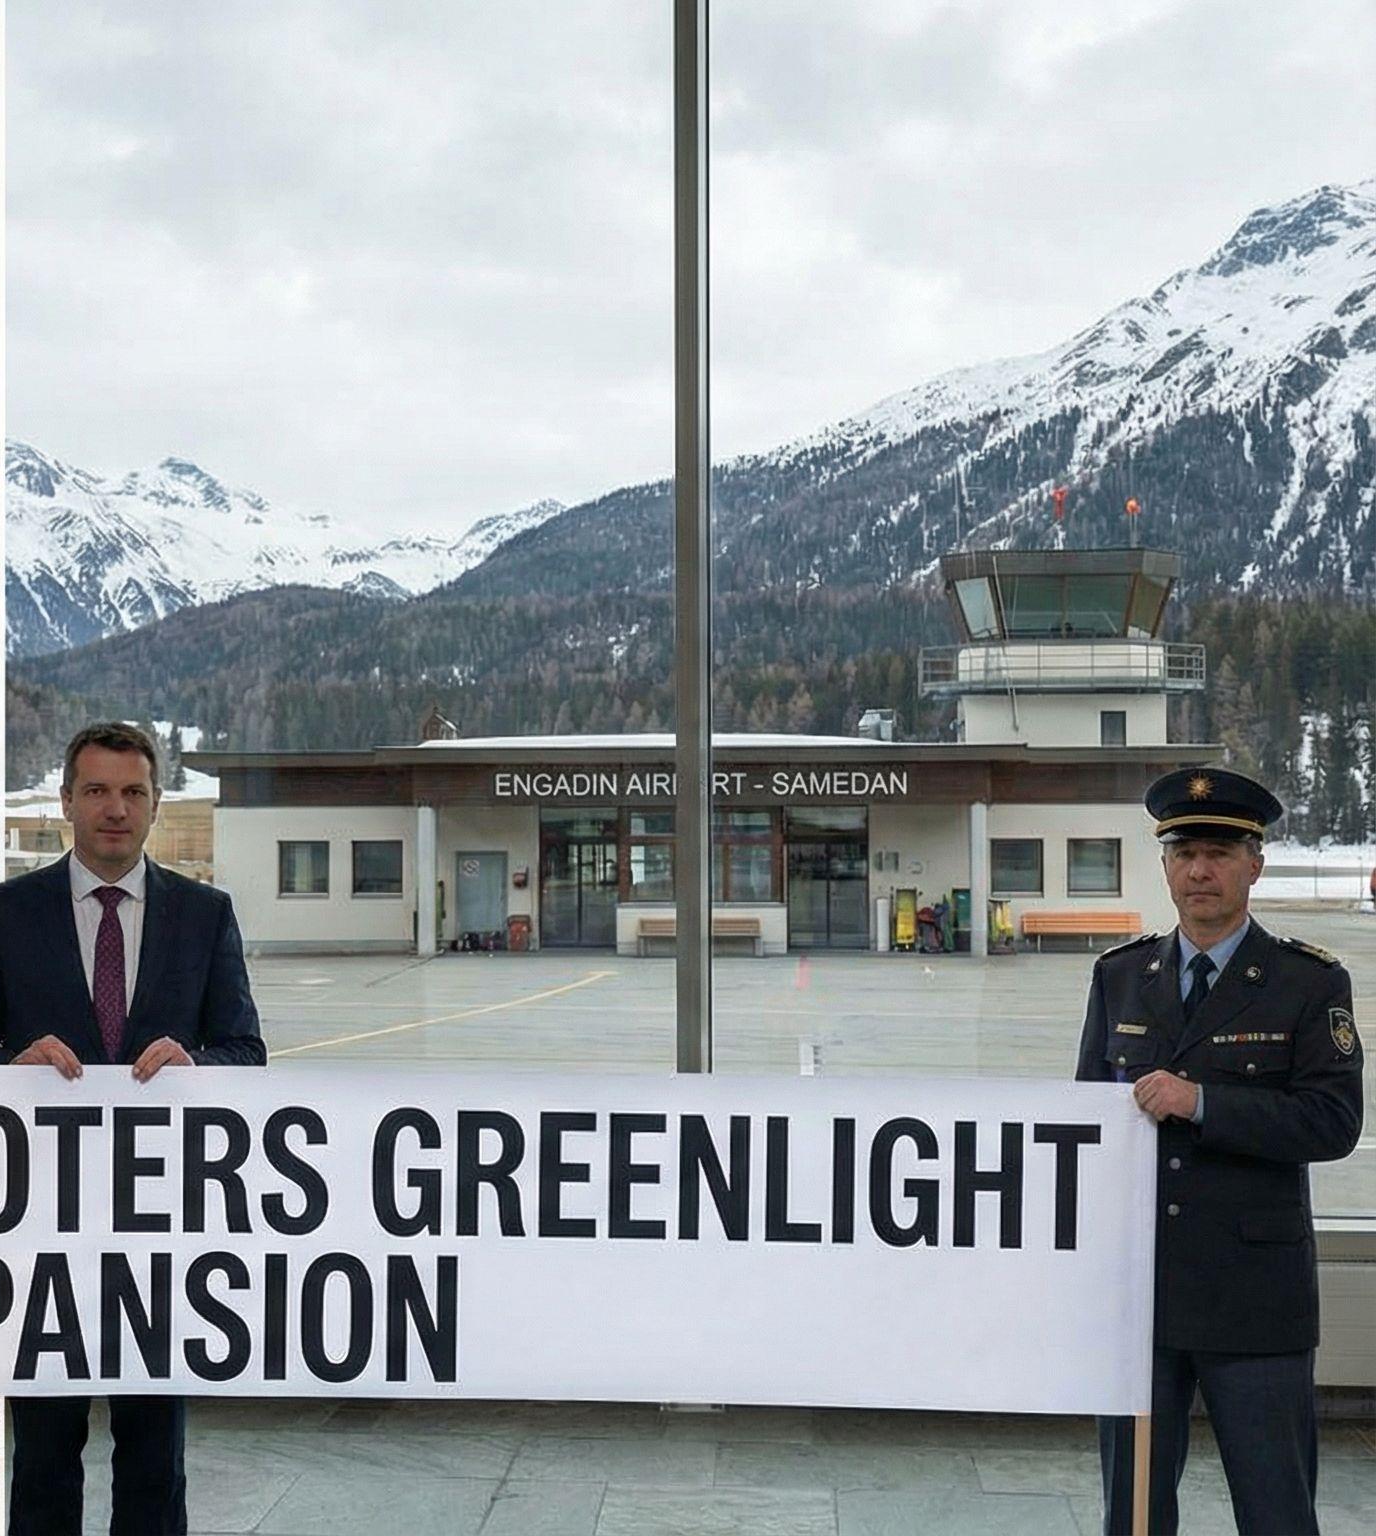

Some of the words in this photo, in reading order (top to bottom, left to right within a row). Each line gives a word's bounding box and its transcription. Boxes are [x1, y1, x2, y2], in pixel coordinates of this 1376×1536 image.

[495, 772, 617, 796] ENGADIN
[625, 772, 747, 796] AIRRT
[772, 772, 907, 795] SAMEDAN
[372, 1107, 1102, 1251] GREENLIGHT
